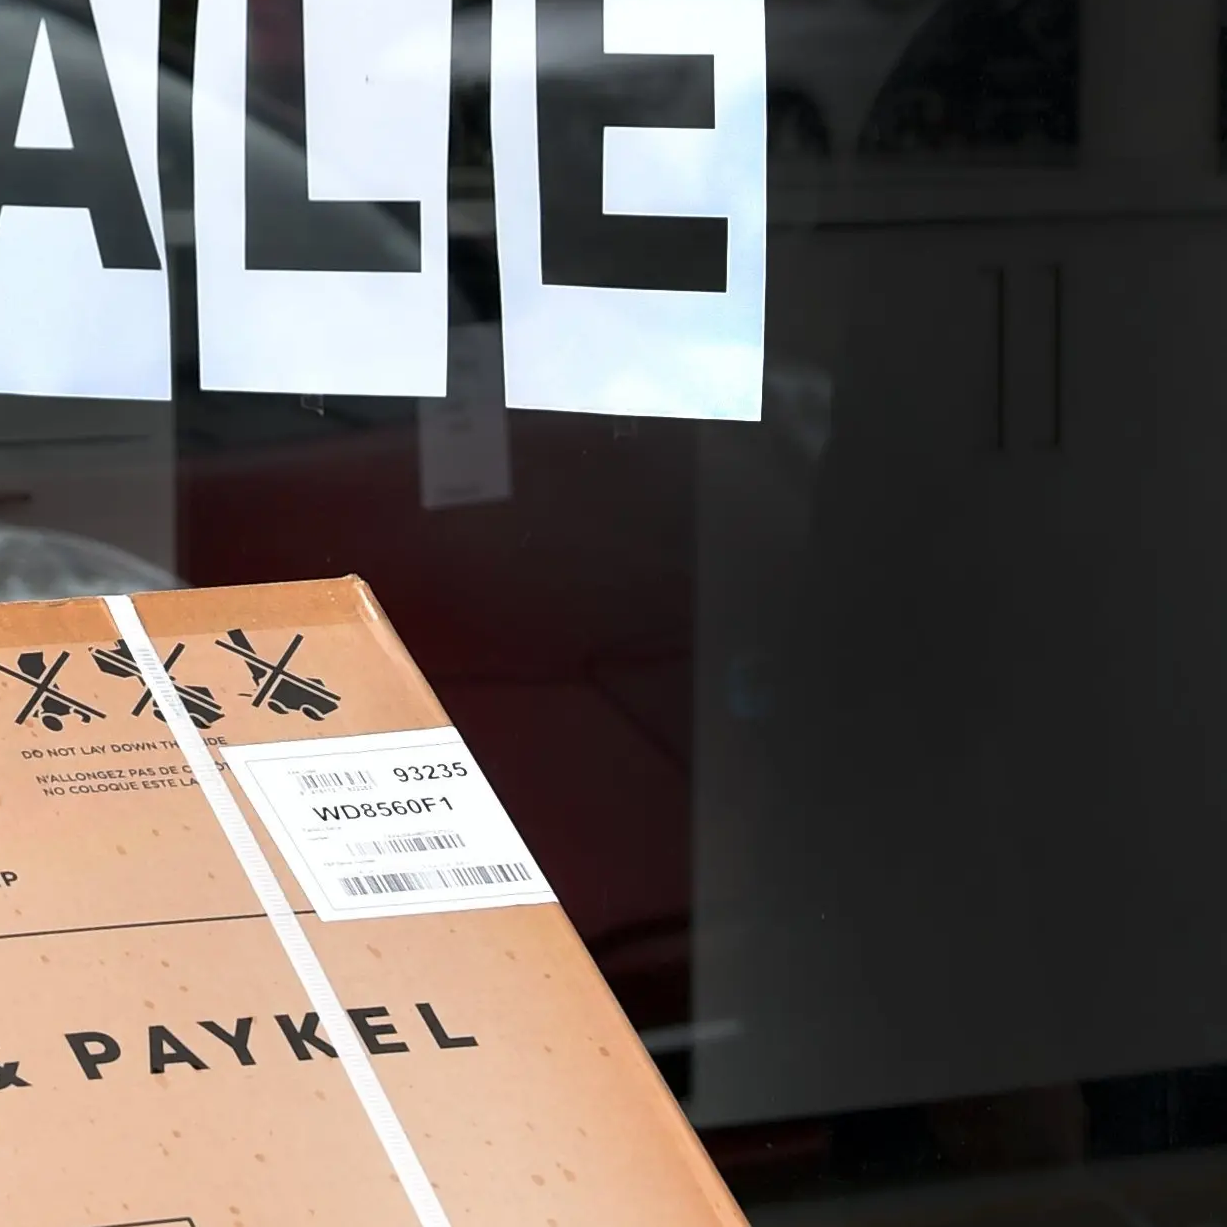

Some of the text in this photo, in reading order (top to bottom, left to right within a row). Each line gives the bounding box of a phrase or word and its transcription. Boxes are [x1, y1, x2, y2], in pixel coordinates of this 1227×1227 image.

[21, 749, 44, 760] DO
[48, 747, 77, 757] NOT
[80, 745, 106, 755] LAY
[111, 742, 158, 754] DOWN
[36, 769, 124, 785] N'ALLONGEZ
[129, 767, 156, 778] PAS
[160, 765, 179, 776] DE
[393, 761, 468, 782] 93235
[42, 787, 65, 798] NO
[69, 782, 139, 795] COLOQUE
[143, 779, 178, 790] ESTE
[312, 796, 454, 822] WD8560F1
[65, 1002, 479, 1080] PAYKEL
